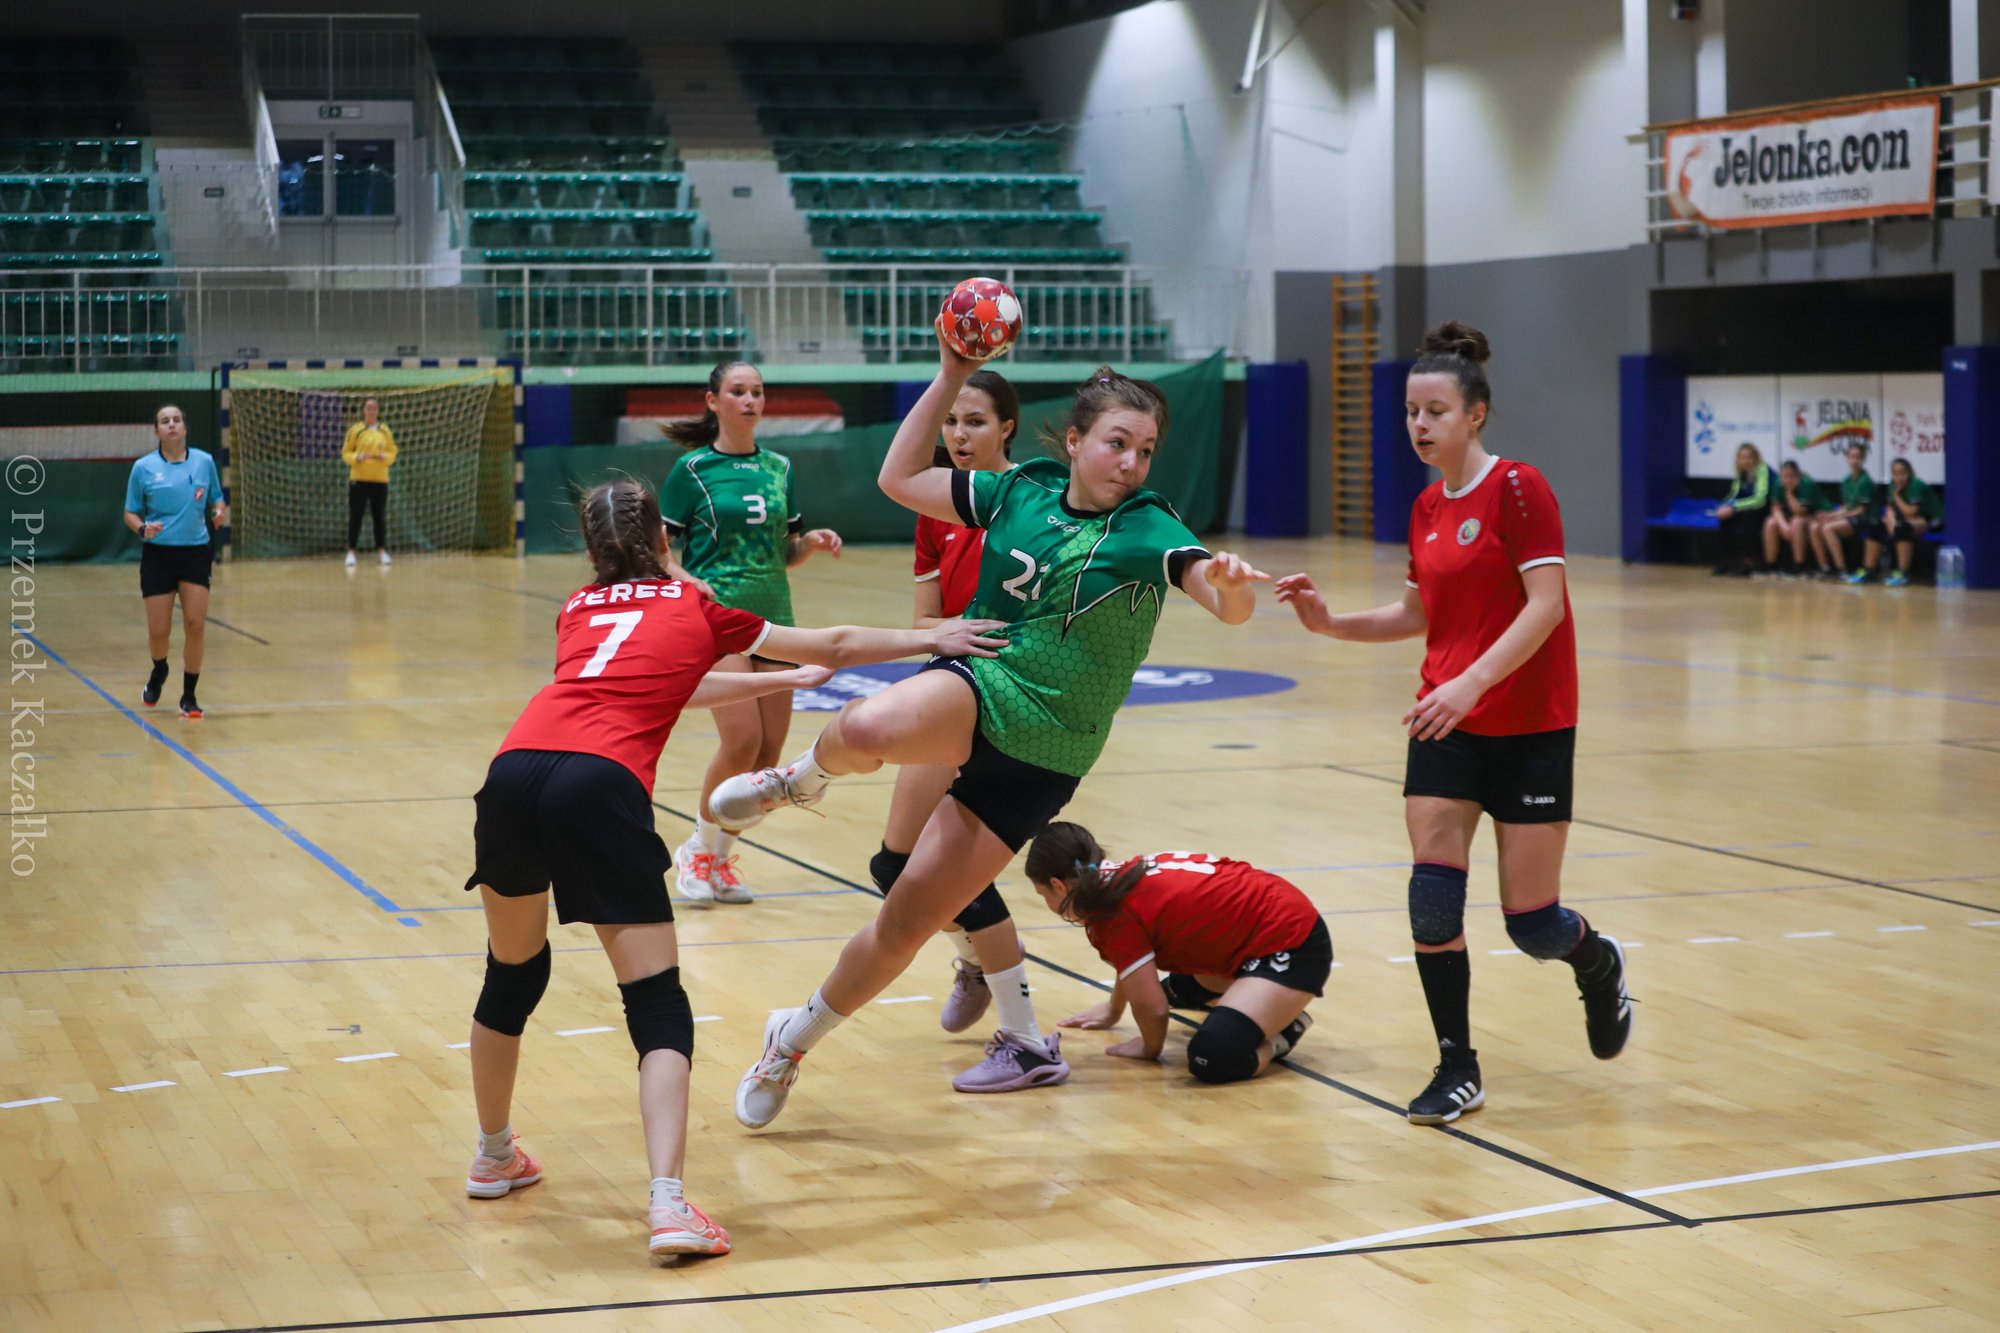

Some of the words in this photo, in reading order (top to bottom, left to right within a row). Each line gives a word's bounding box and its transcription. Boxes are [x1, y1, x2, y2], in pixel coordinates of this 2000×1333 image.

[1714, 128, 1912, 188] Jelonka.com
[1816, 401, 1873, 428] JELENIA
[742, 494, 768, 524] 3
[578, 610, 644, 679] 7
